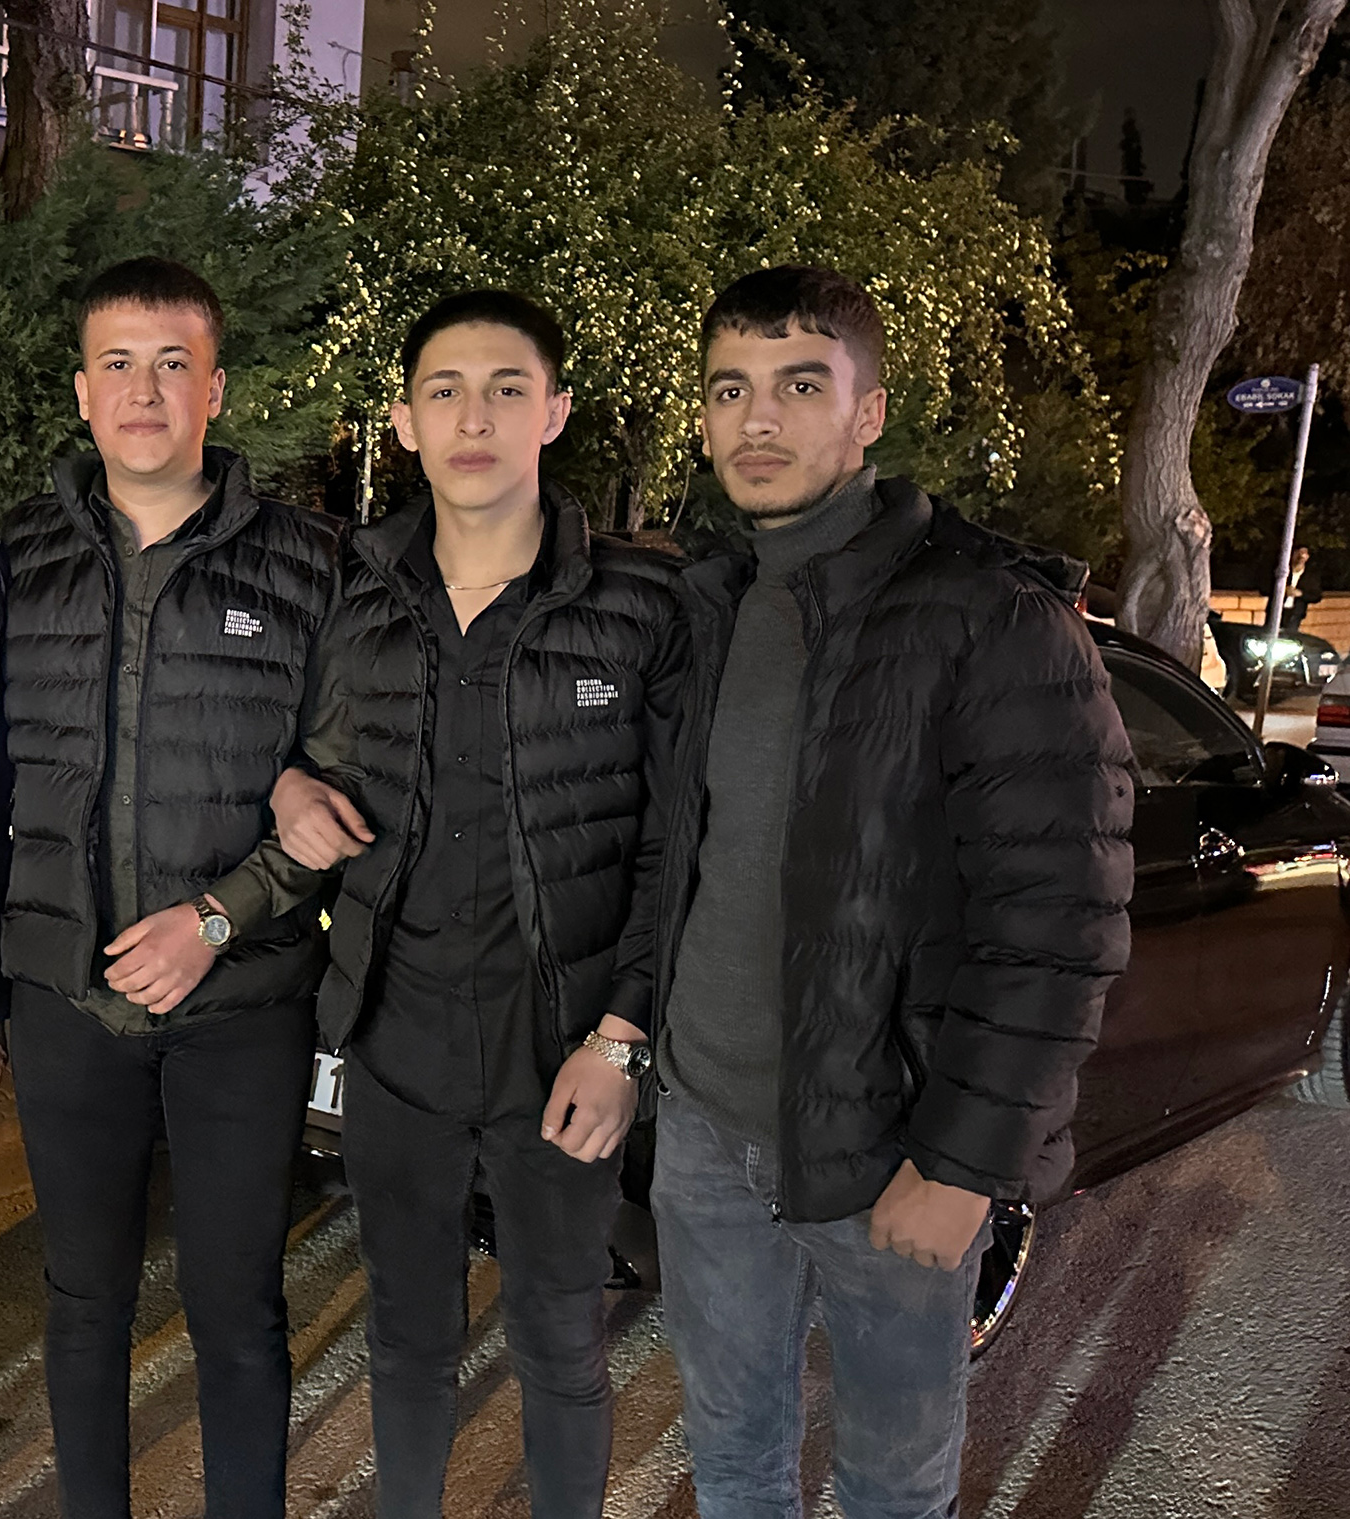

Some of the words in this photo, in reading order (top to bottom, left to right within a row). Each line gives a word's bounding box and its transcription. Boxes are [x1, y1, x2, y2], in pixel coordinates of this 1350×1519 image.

[225, 615, 260, 626] COLLECTION
[225, 621, 263, 632] FASHIONABLE
[224, 627, 252, 637] CLOTHING
[576, 684, 615, 693] COLLECTION
[576, 691, 619, 699] FASHIONABLE
[577, 698, 609, 707] CLOTHING
